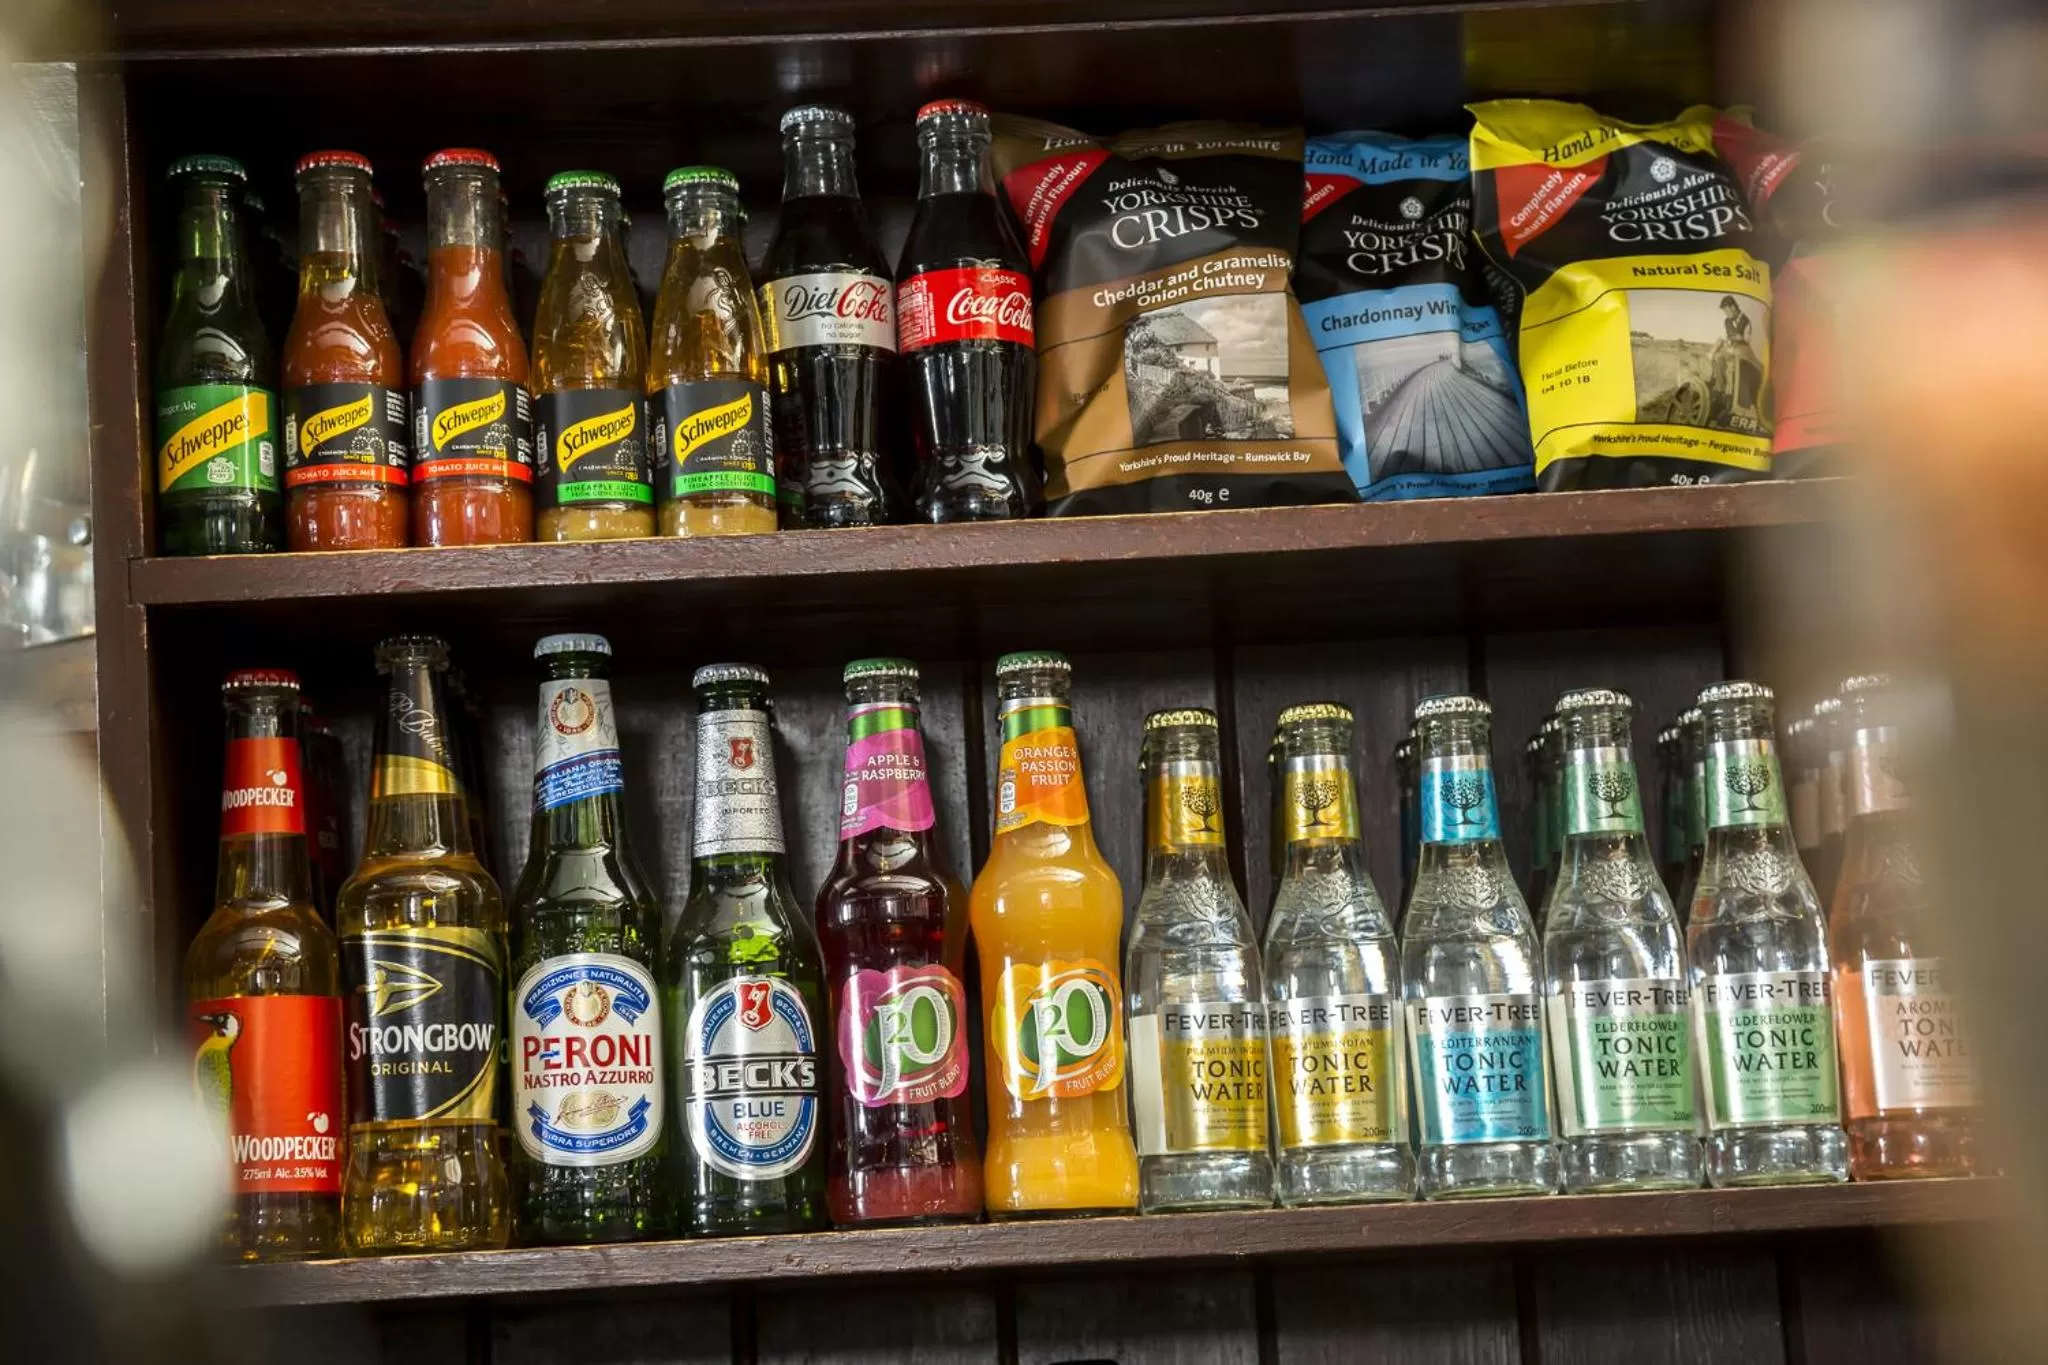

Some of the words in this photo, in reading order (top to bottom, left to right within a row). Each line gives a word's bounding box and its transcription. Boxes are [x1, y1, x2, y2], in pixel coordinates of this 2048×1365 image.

[1543, 131, 1595, 163] Hand
[1358, 153, 1415, 175] Made
[1420, 152, 1441, 168] in
[1029, 198, 1053, 247] Natural
[1048, 159, 1089, 202] Flavours
[1103, 188, 1252, 215] YORKSHIRE
[1510, 169, 1565, 228] Completely
[1546, 171, 1588, 216] Flavours
[1604, 182, 1680, 211] Deliciously
[1110, 203, 1260, 250] CRISPS
[1632, 263, 1699, 278] Natural
[1702, 262, 1732, 277] Sea
[1735, 263, 1761, 286] Salt
[1092, 276, 1164, 308] Cheddar
[1167, 265, 1198, 287] and
[1136, 287, 1188, 307] Onion
[1192, 272, 1266, 301] Chutney
[784, 284, 839, 322] Diet
[836, 281, 889, 323] Coke
[1321, 303, 1424, 333] Chardonnay
[1565, 358, 1599, 373] Before
[182, 400, 197, 411] Ale
[306, 404, 369, 447] Schweppes
[438, 400, 503, 441] Schweppes
[680, 404, 748, 452] Schweppes
[563, 414, 632, 461] Schweppes
[1661, 435, 1700, 448] Heritage
[464, 463, 490, 471] JUICE
[1119, 455, 1163, 473] Yorkshire's
[1163, 453, 1191, 463] Proud
[1192, 451, 1236, 464] Heritage
[1244, 451, 1293, 463] Runswick
[1293, 451, 1312, 464] Bay
[1188, 488, 1214, 504] 40g
[867, 754, 911, 768] APPLE
[1013, 745, 1070, 760] ORANGE
[861, 767, 927, 782] RASPBERRY
[1020, 760, 1076, 773] PASSION
[1031, 773, 1071, 786] FRUIT
[1418, 1002, 1541, 1025] FVER-TREE
[350, 1021, 493, 1061] STRONGBOW
[1427, 1035, 1533, 1050] EDITERRANEAN
[1598, 1036, 1677, 1056] TONIC
[1733, 1028, 1815, 1049] TONIC
[522, 1034, 652, 1073] PERONI
[1289, 1052, 1369, 1073] TONIC
[1441, 1051, 1524, 1073] TONIC
[1732, 1051, 1819, 1073] WATER
[371, 1060, 453, 1077] ORIGINAL
[524, 1072, 582, 1091] NASTRO
[584, 1068, 654, 1086] AZZURRO
[691, 1057, 816, 1094] BECK'S
[1191, 1060, 1262, 1079] TONIC
[1597, 1058, 1682, 1079] WATER
[909, 1081, 938, 1100] FRUIT
[939, 1062, 961, 1090] BLEND
[1065, 1073, 1095, 1091] FRUIT
[1191, 1082, 1264, 1101] WATER
[1289, 1074, 1375, 1096] WATER
[1442, 1073, 1529, 1095] WATER
[733, 1100, 786, 1119] BLUE
[736, 1120, 784, 1132] ALCOHOL
[748, 1129, 773, 1139] FREE
[575, 1126, 640, 1149] SUPERIORE
[709, 1128, 754, 1160] BREMEN
[762, 1126, 806, 1160] GERMANY
[231, 1134, 337, 1165] WOODPECKER
[242, 1167, 272, 1181] 275ml
[274, 1166, 293, 1180] Alc.
